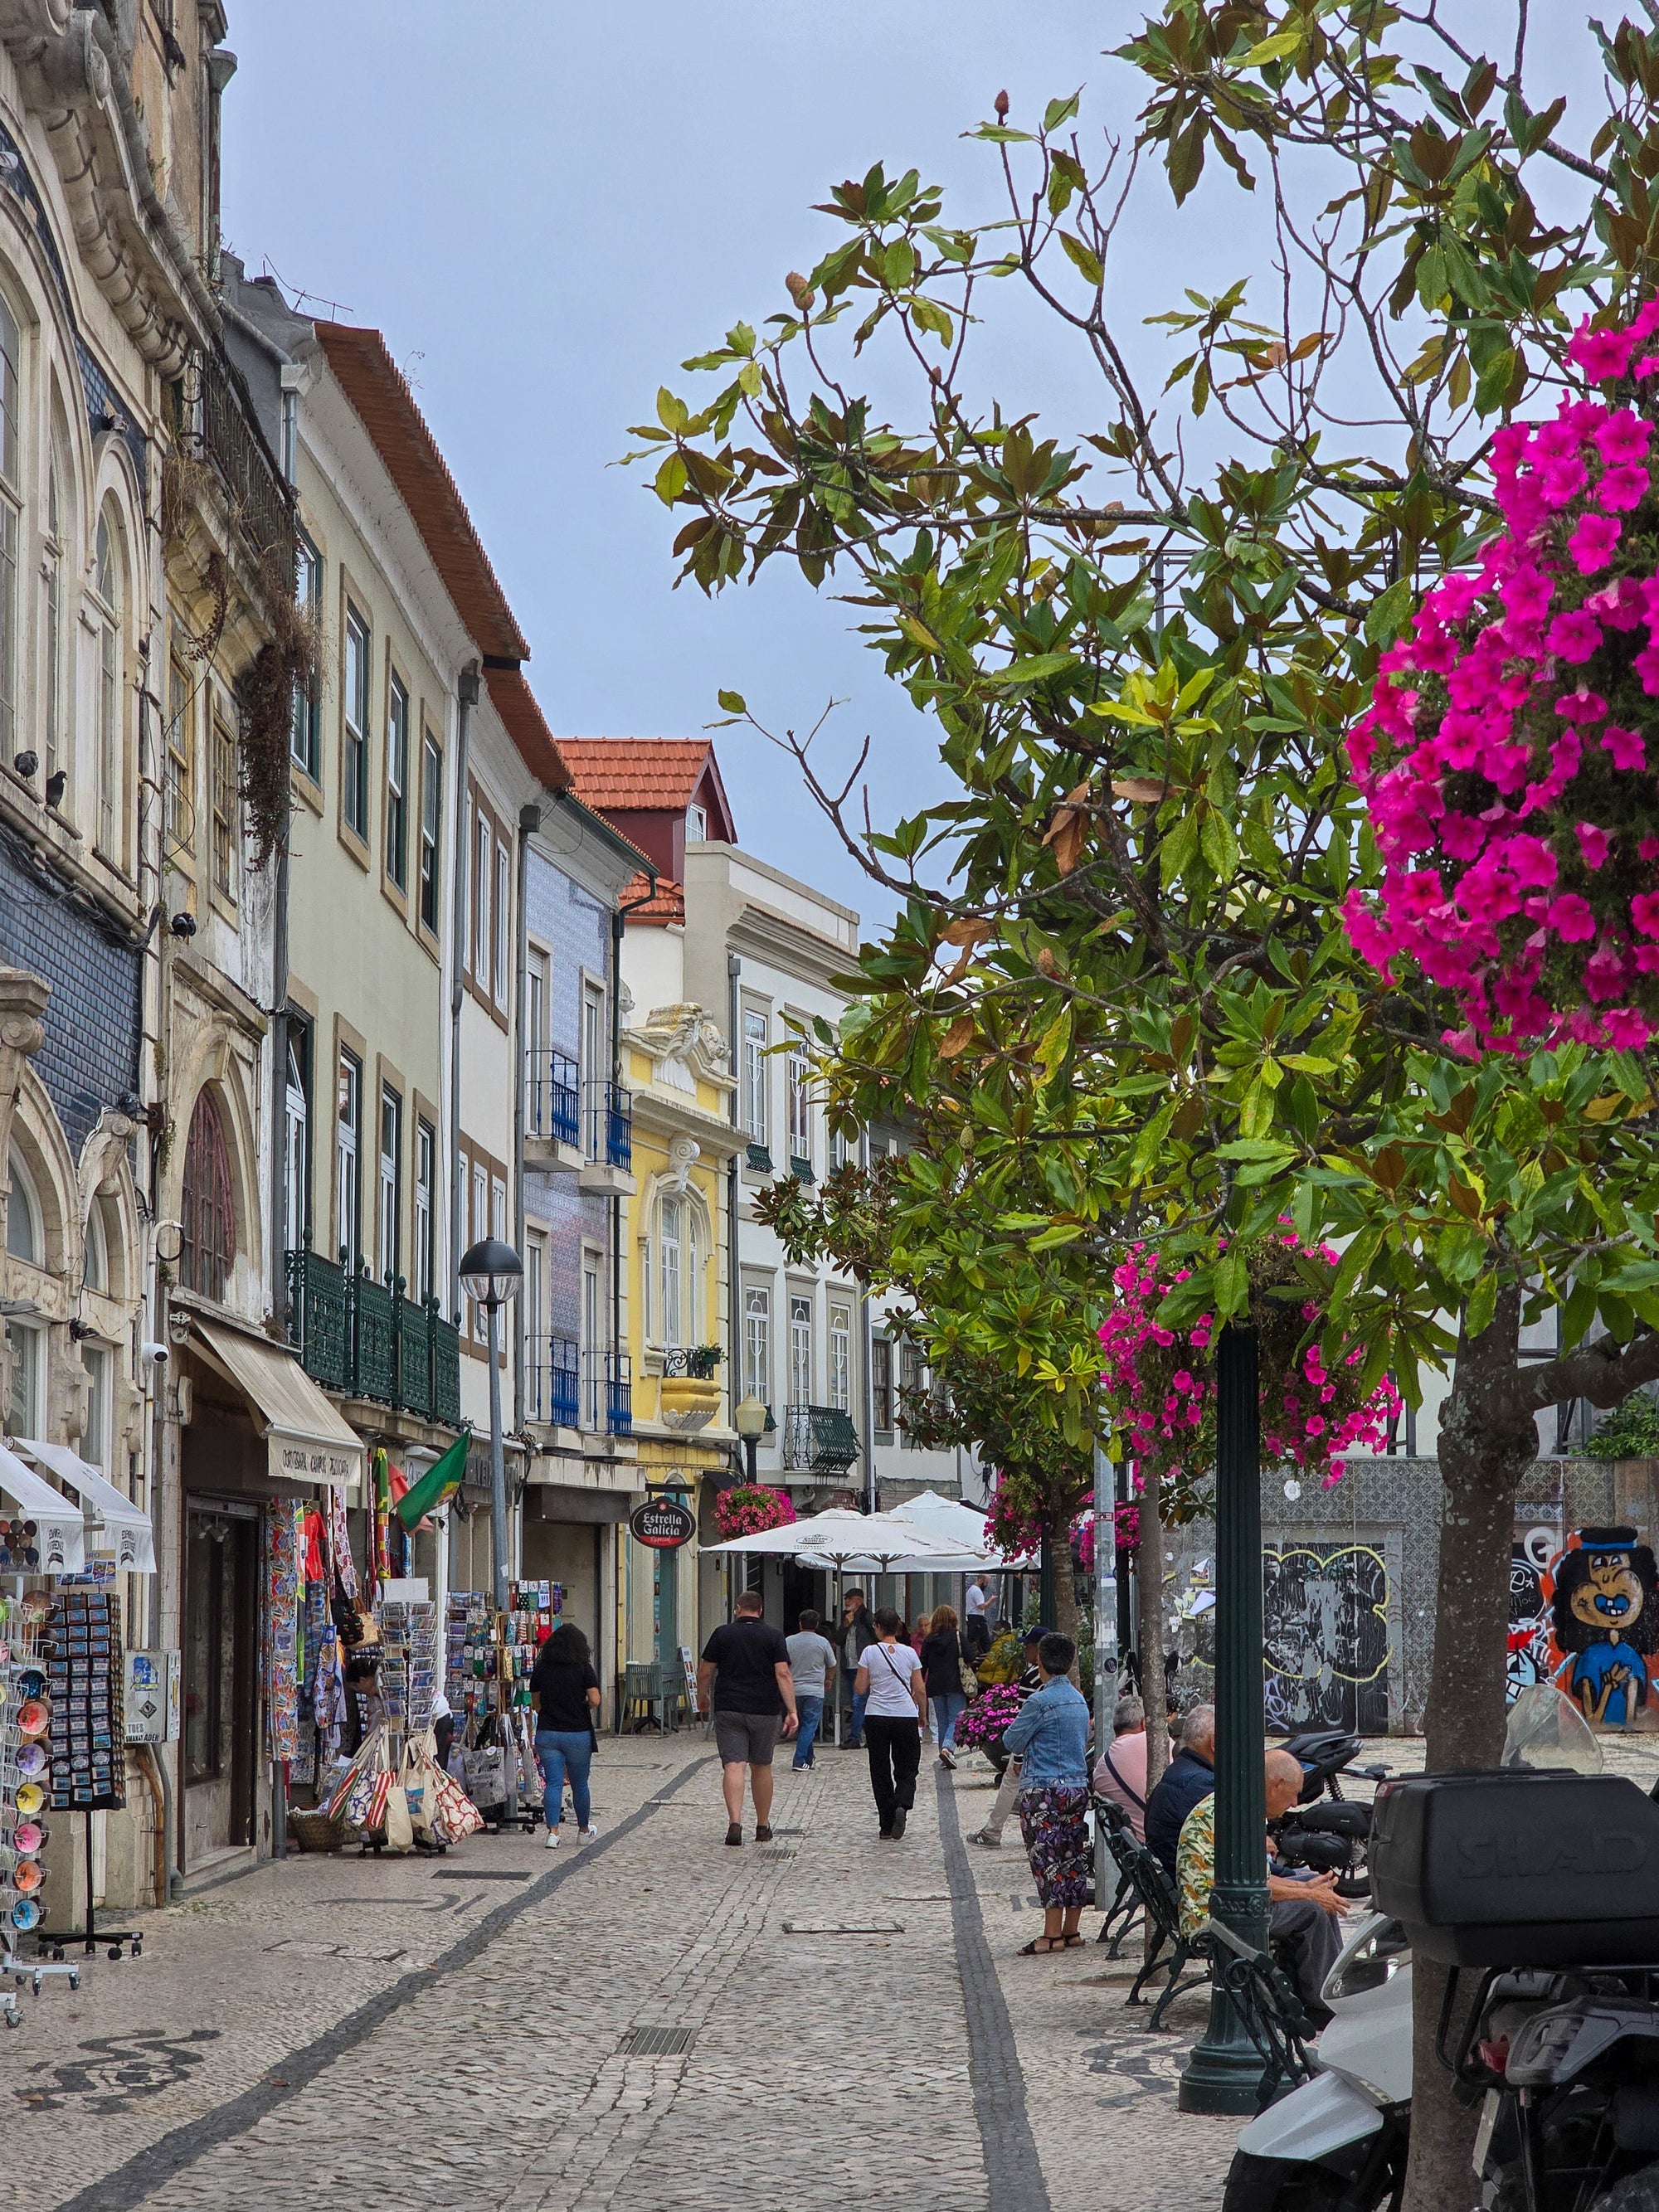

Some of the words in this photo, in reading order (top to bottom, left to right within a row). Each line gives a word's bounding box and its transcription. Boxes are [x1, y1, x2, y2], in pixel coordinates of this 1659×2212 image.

[643, 1512, 682, 1524] Estrella
[643, 1524, 680, 1536] Galicia
[127, 1723, 144, 1733] TOES
